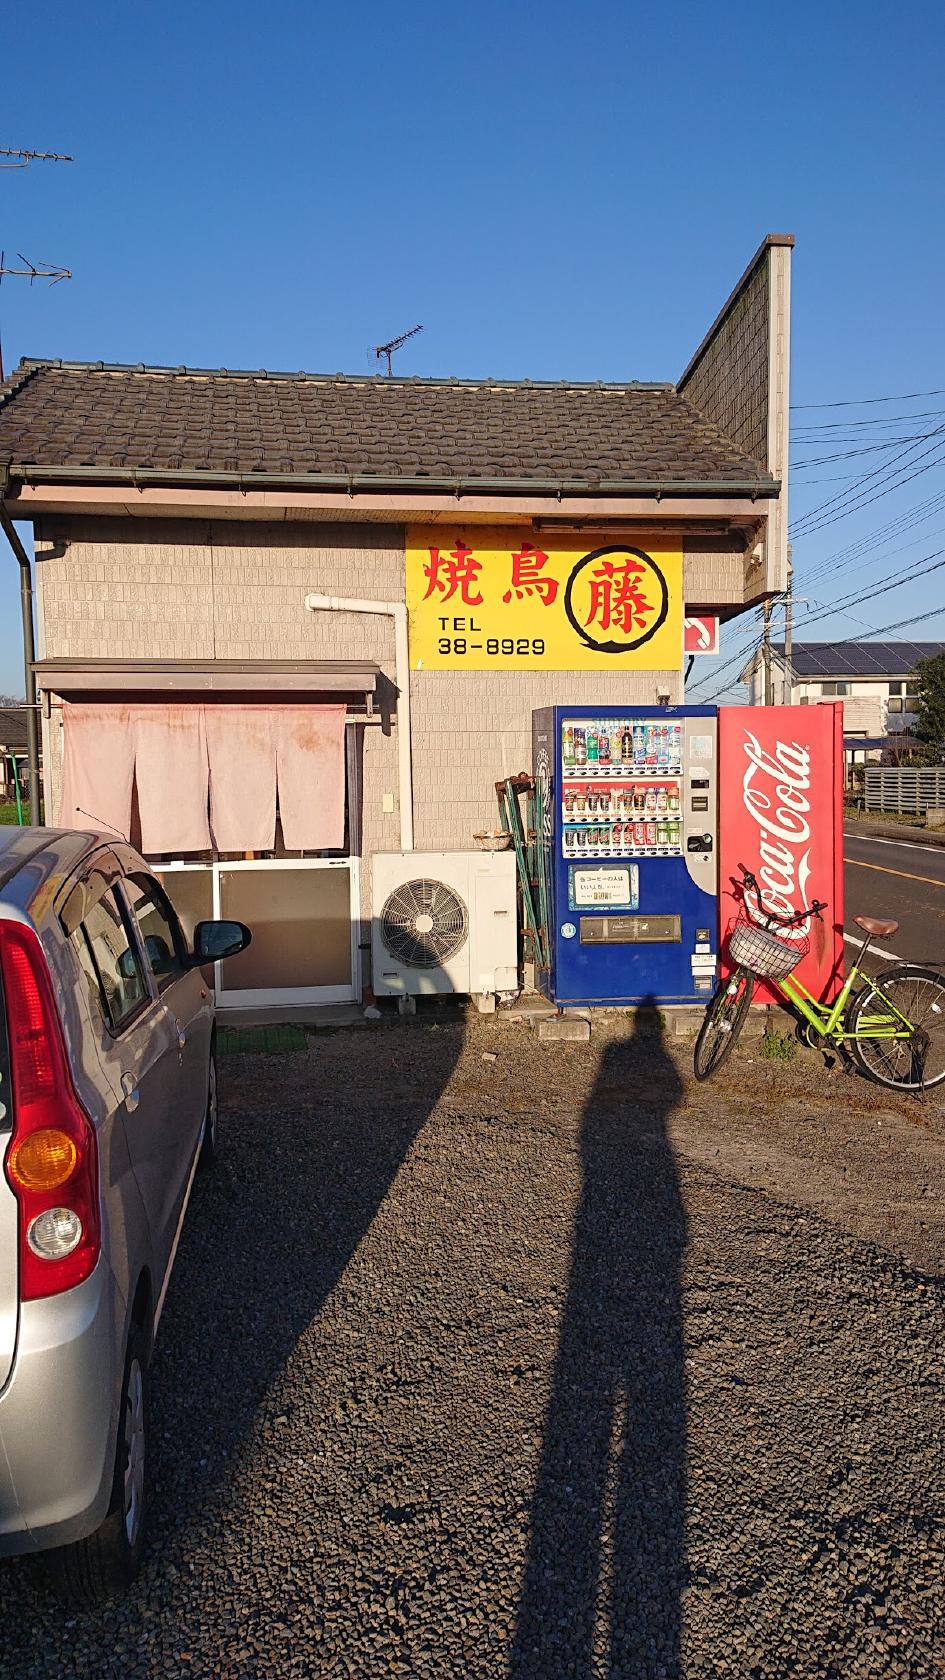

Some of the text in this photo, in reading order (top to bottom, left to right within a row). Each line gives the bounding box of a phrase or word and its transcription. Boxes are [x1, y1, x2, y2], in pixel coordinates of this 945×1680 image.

[422, 540, 655, 634] 焼鳥 藤
[438, 617, 482, 632] TEL
[438, 638, 546, 655] 38-8929
[743, 728, 811, 940] Coca-Cola
